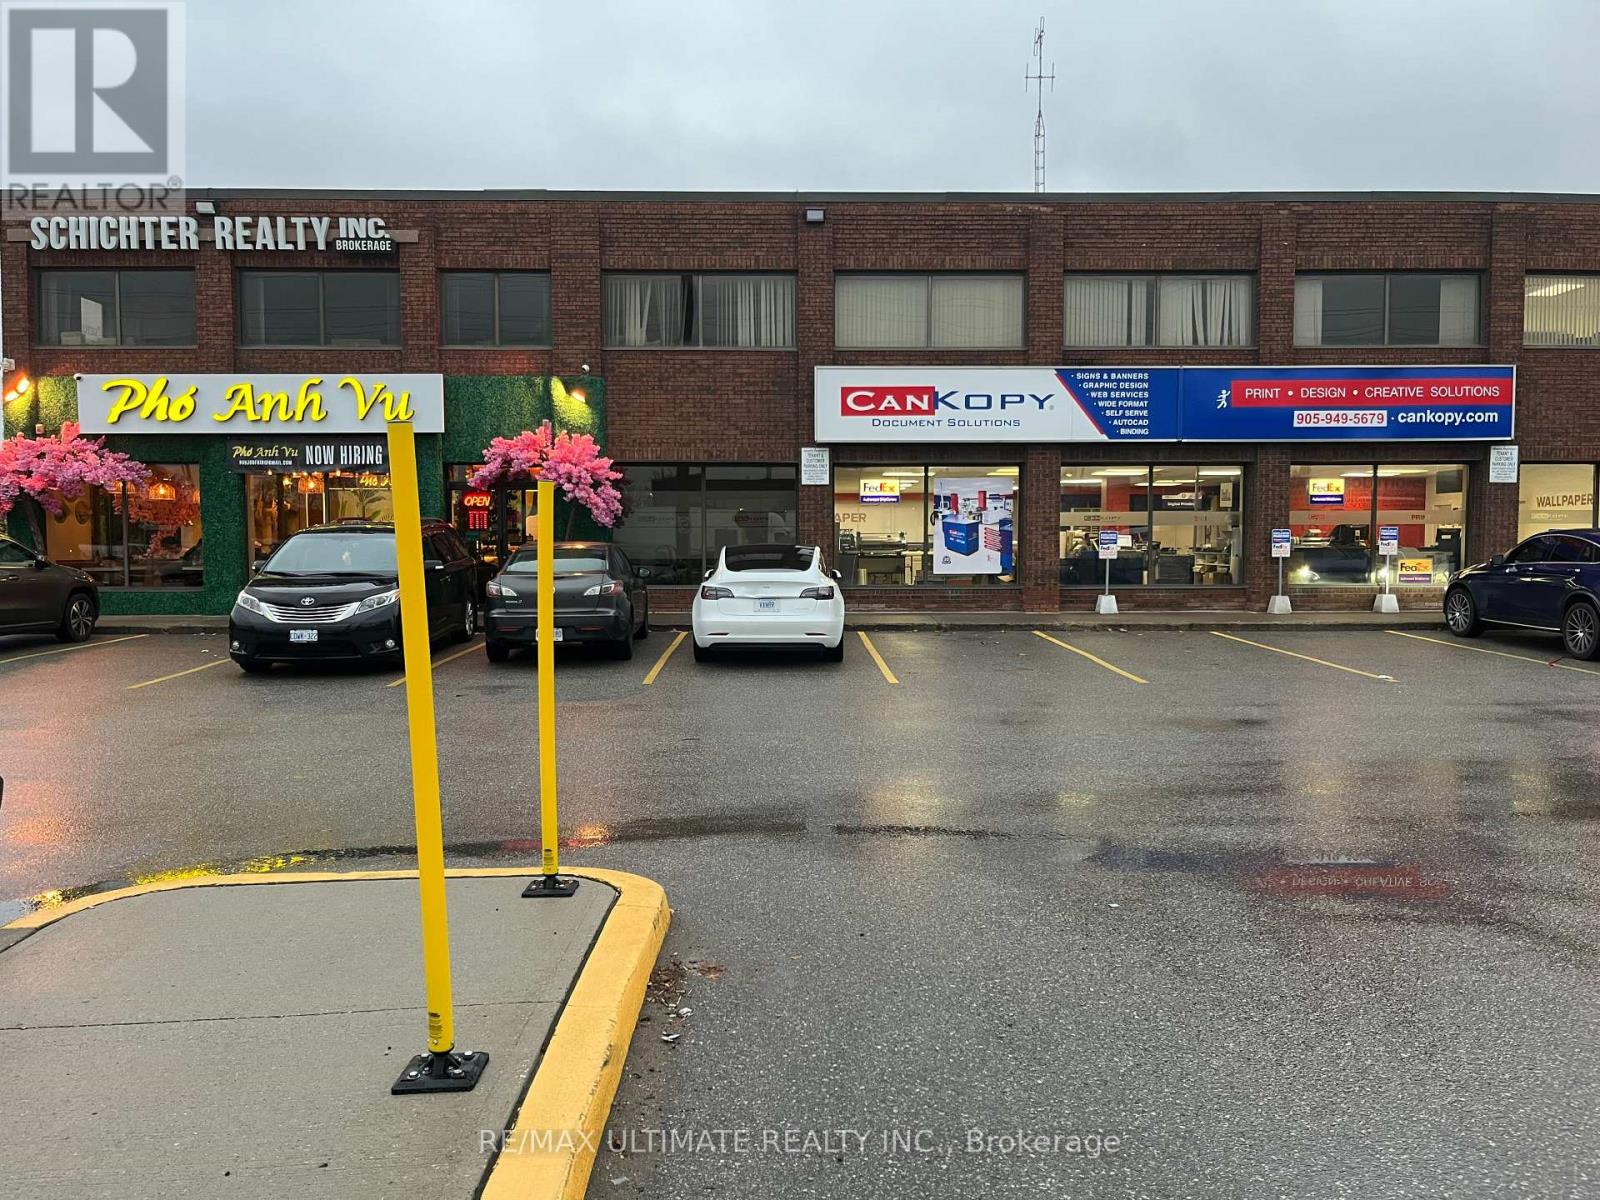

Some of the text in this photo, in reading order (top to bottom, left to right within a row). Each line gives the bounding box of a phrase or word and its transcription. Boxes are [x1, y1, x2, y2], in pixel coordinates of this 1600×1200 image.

[30, 216, 390, 250] SCHICHTER REALTY INC.
[336, 239, 391, 251] BROKERAGE
[213, 377, 327, 422] Anh
[338, 376, 415, 422] Vu
[1245, 386, 1500, 399] PRINT DESIGN CREATIVE SOLUTIONS
[1296, 409, 1499, 425] 905-949-5679 cankopy.com
[254, 445, 279, 458] Anh
[281, 446, 299, 457] Vu
[305, 445, 383, 465] NOW HIRING
[863, 482, 896, 493] FedEx
[1312, 482, 1341, 493] FedEx
[464, 495, 491, 507] OPEN
[1536, 493, 1593, 508] WALLPAPER
